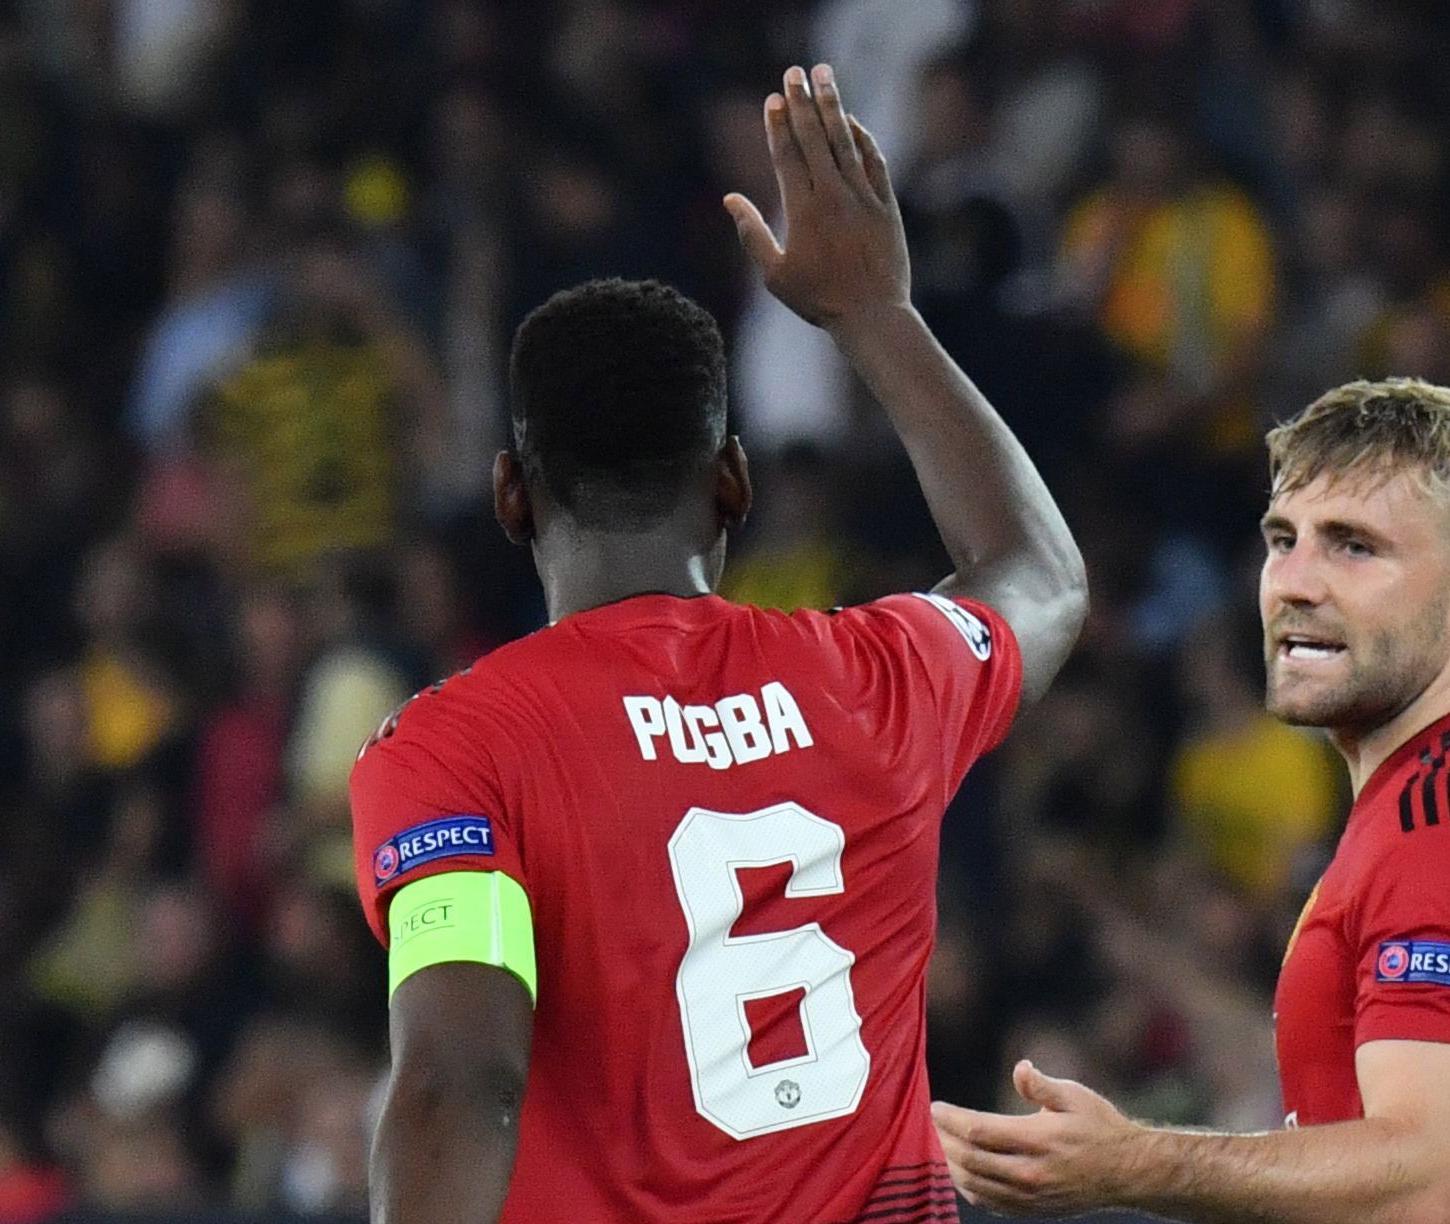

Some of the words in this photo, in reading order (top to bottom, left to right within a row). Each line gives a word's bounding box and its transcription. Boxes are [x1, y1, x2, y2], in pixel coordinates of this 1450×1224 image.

[624, 682, 813, 769] POGBA
[399, 826, 490, 861] RESPECT
[394, 904, 454, 941] PECT
[667, 801, 870, 1141] 6
